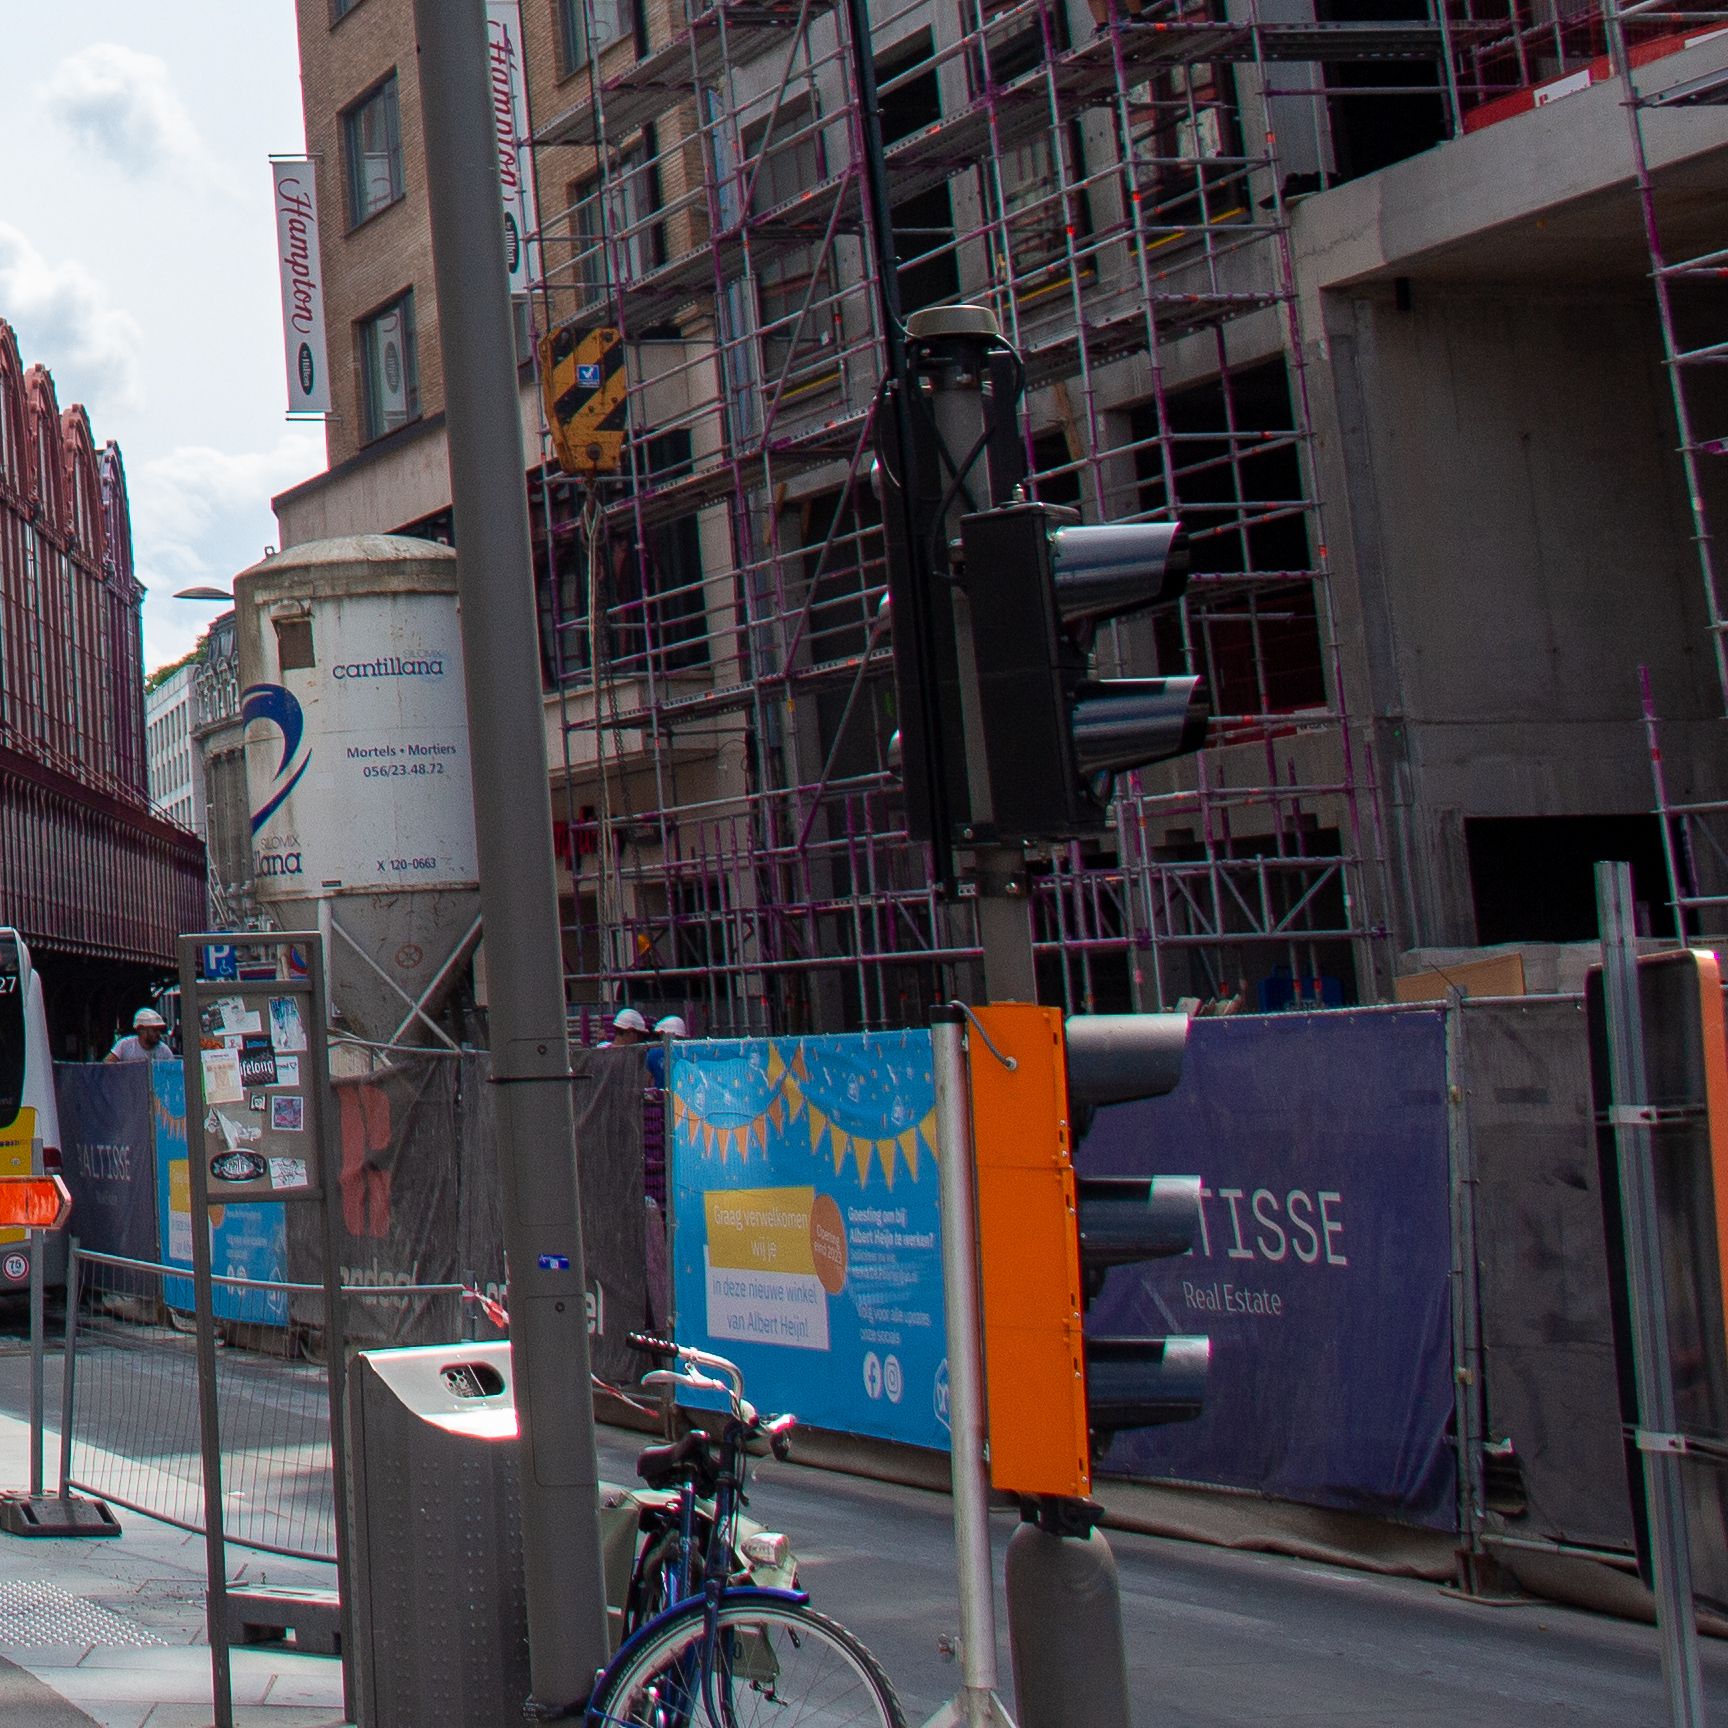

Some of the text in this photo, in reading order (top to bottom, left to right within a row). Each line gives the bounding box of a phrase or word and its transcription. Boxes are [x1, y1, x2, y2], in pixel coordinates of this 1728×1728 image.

[278, 178, 316, 334] Hampton
[332, 656, 444, 680] cantillana
[346, 742, 457, 759] Mortels Mortiers
[363, 762, 444, 778] 056/23.48.72
[390, 857, 437, 871] 120-0663
[714, 1204, 808, 1232] Graag verwelkomen
[712, 1275, 817, 1305] in deze nieuwe winkel
[1182, 1280, 1282, 1316] Real Estate
[726, 1311, 809, 1342] van Albert Heijn!
